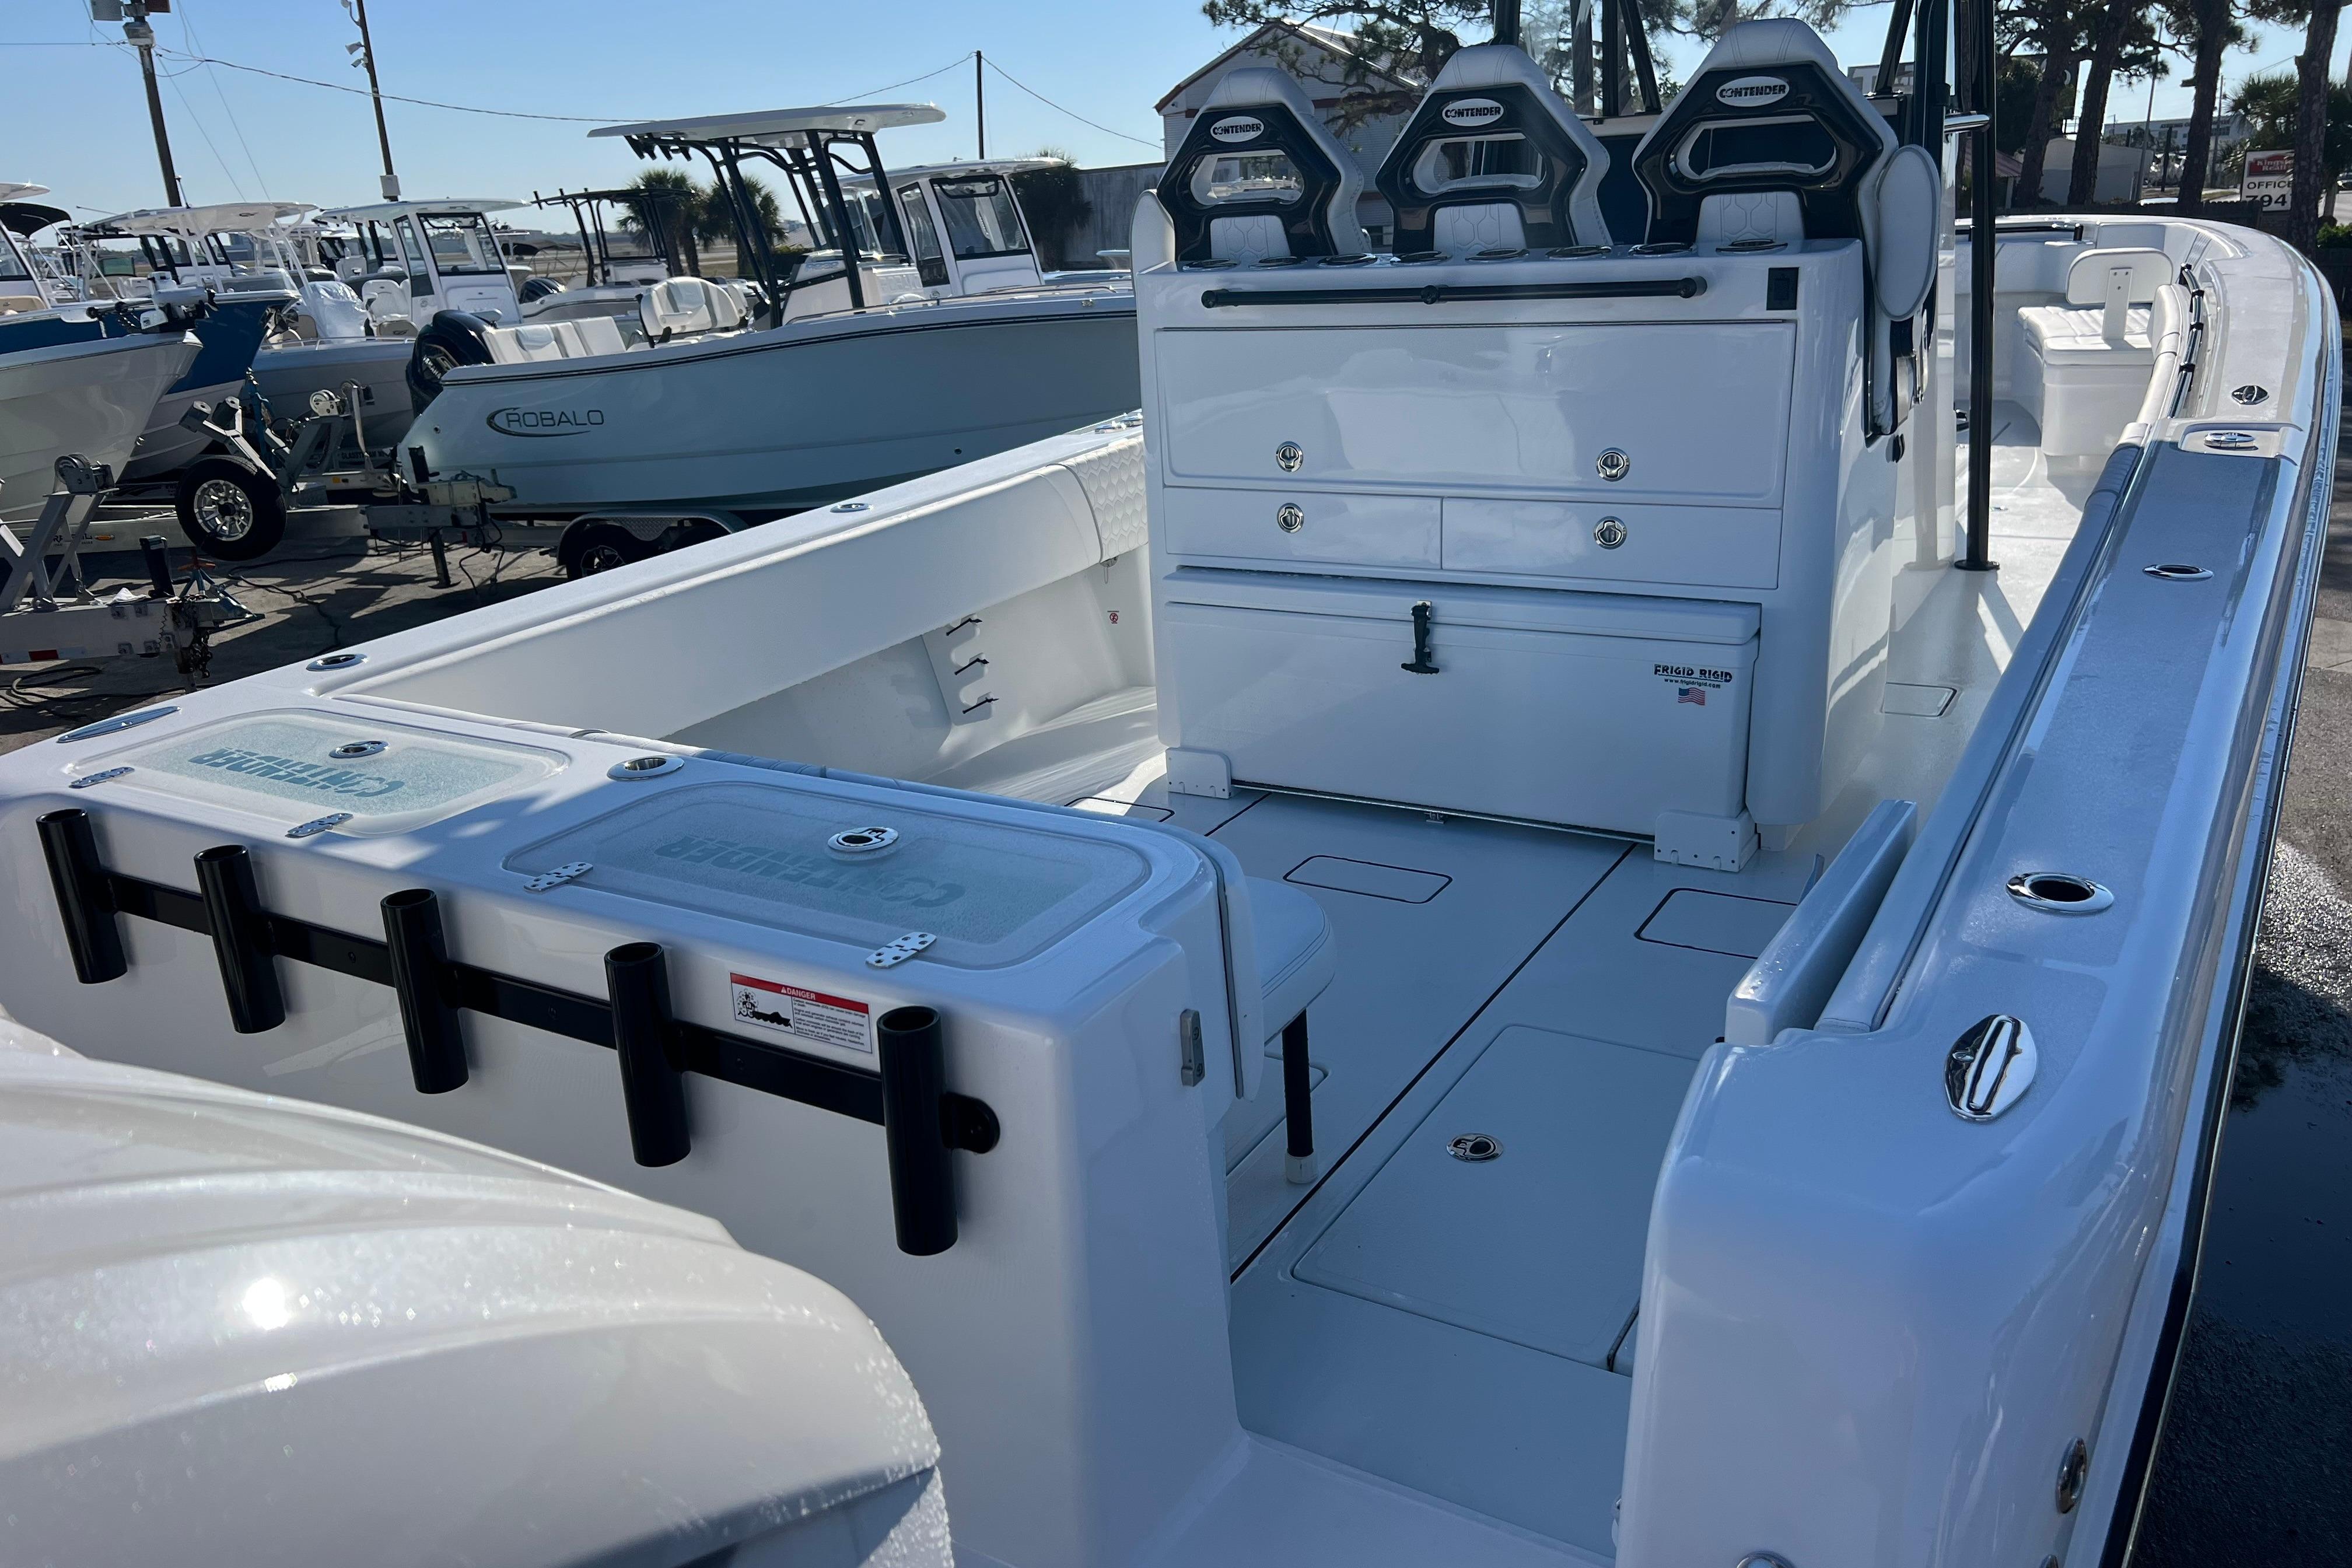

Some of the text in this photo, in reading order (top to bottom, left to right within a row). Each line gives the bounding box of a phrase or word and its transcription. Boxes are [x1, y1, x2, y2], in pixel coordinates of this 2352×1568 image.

[1718, 84, 1786, 99] CONTENDER
[1444, 106, 1501, 118] CONTENDER
[1212, 123, 1262, 135] CONTENDER
[505, 410, 604, 428] ROBALO
[1654, 663, 1732, 683] FRIGID RIGID
[1664, 677, 1721, 689] www.frigidrigid.com
[188, 747, 405, 797] CONTENDER
[787, 987, 816, 1000] DANGER
